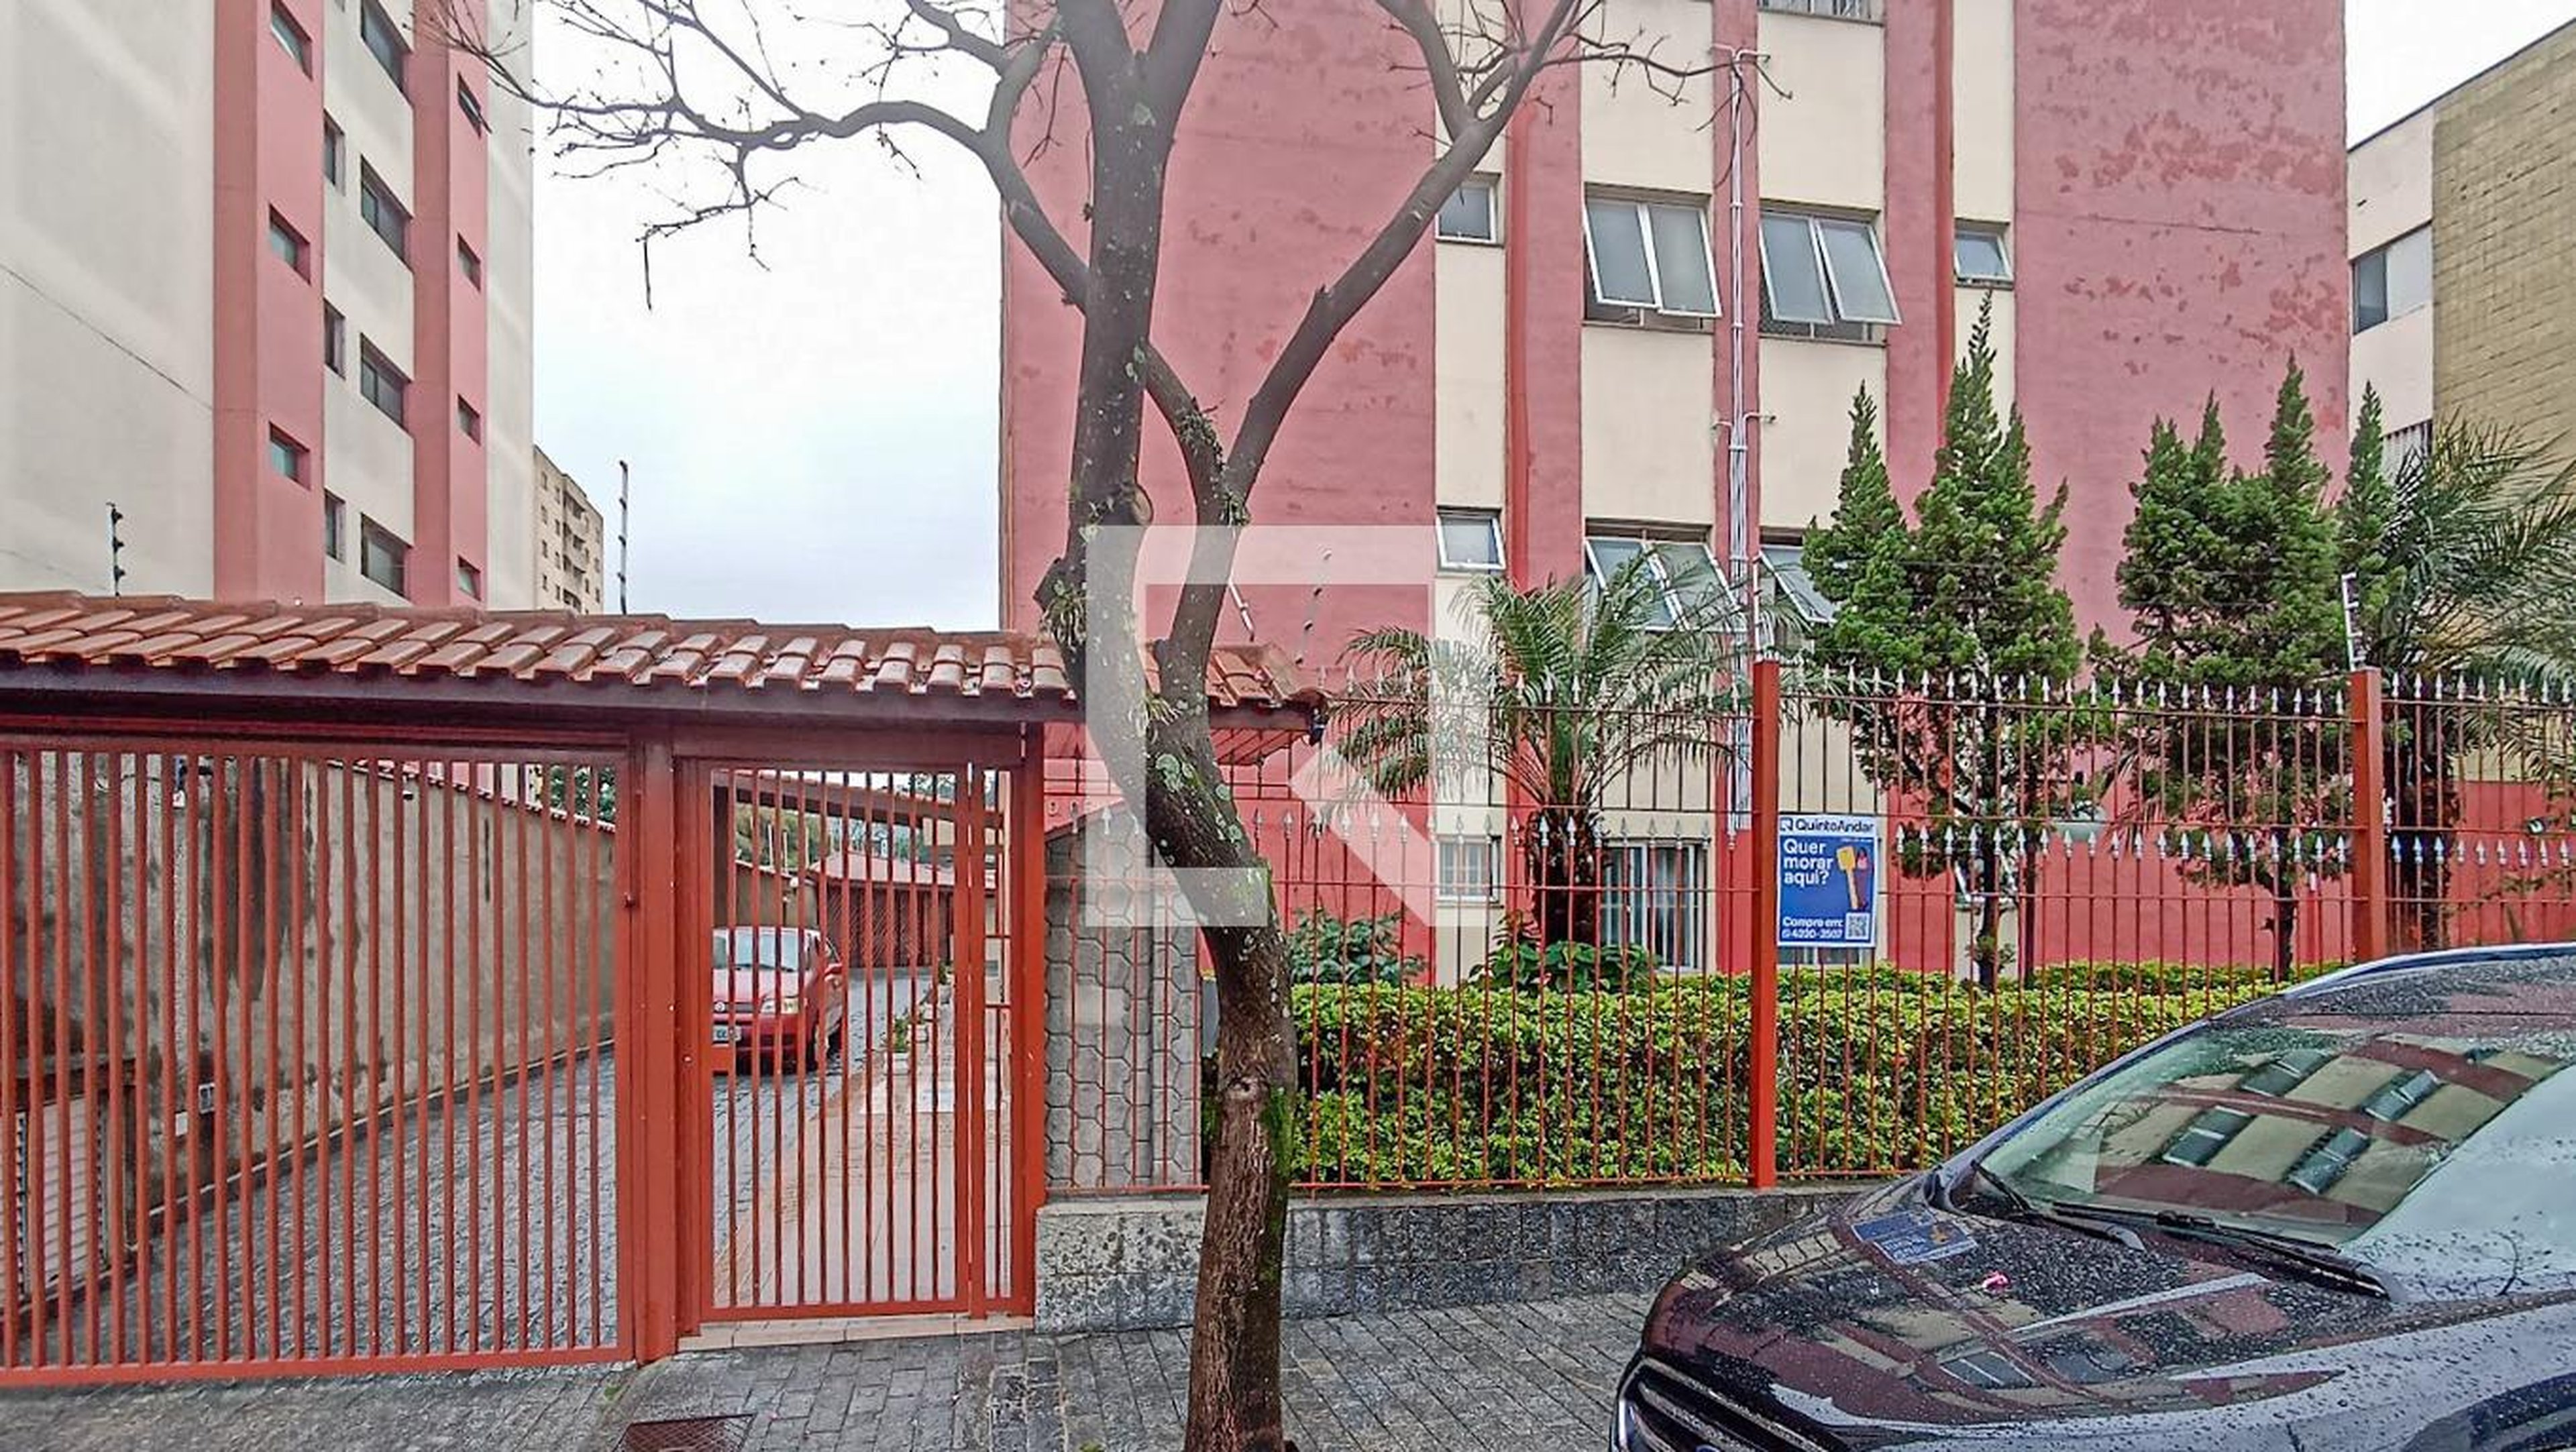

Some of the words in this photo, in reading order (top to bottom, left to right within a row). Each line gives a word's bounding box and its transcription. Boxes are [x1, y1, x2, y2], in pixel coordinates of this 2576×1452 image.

[1795, 818, 1874, 832] QuintoAndar
[1783, 838, 1827, 854] Quer
[1783, 855, 1834, 869] morar
[1784, 870, 1830, 887] aqui?
